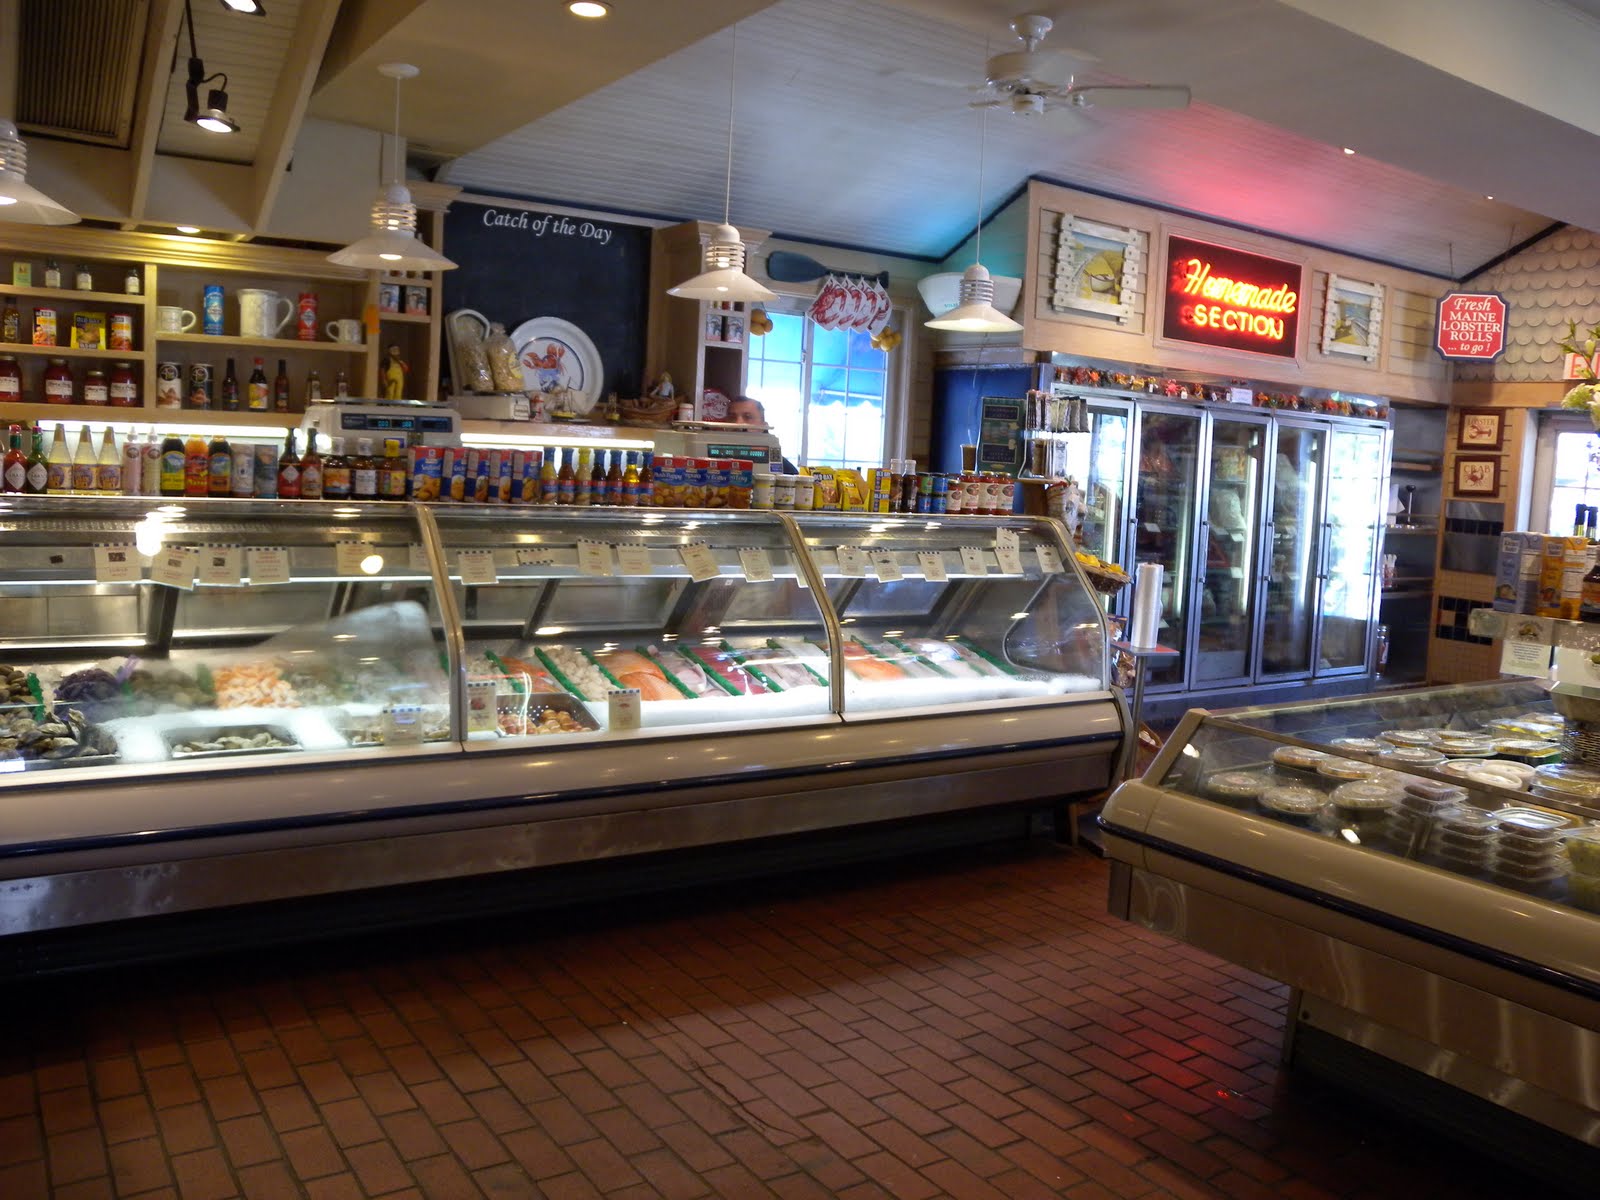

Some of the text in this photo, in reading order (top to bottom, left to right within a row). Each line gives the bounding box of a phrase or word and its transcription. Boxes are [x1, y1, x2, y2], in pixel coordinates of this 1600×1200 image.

[483, 209, 612, 245] Catch of the Day
[1183, 258, 1297, 314] Homemade
[1454, 297, 1491, 311] Fresh
[1192, 303, 1284, 341] SECTION
[1449, 311, 1497, 322] MAINE
[1442, 321, 1501, 333] LOBSTER
[1450, 331, 1493, 342] ROLLS
[1460, 343, 1470, 351] to
[1471, 344, 1484, 354] go
[1467, 417, 1496, 426] LOBSTER
[1463, 464, 1491, 474] CRAB
